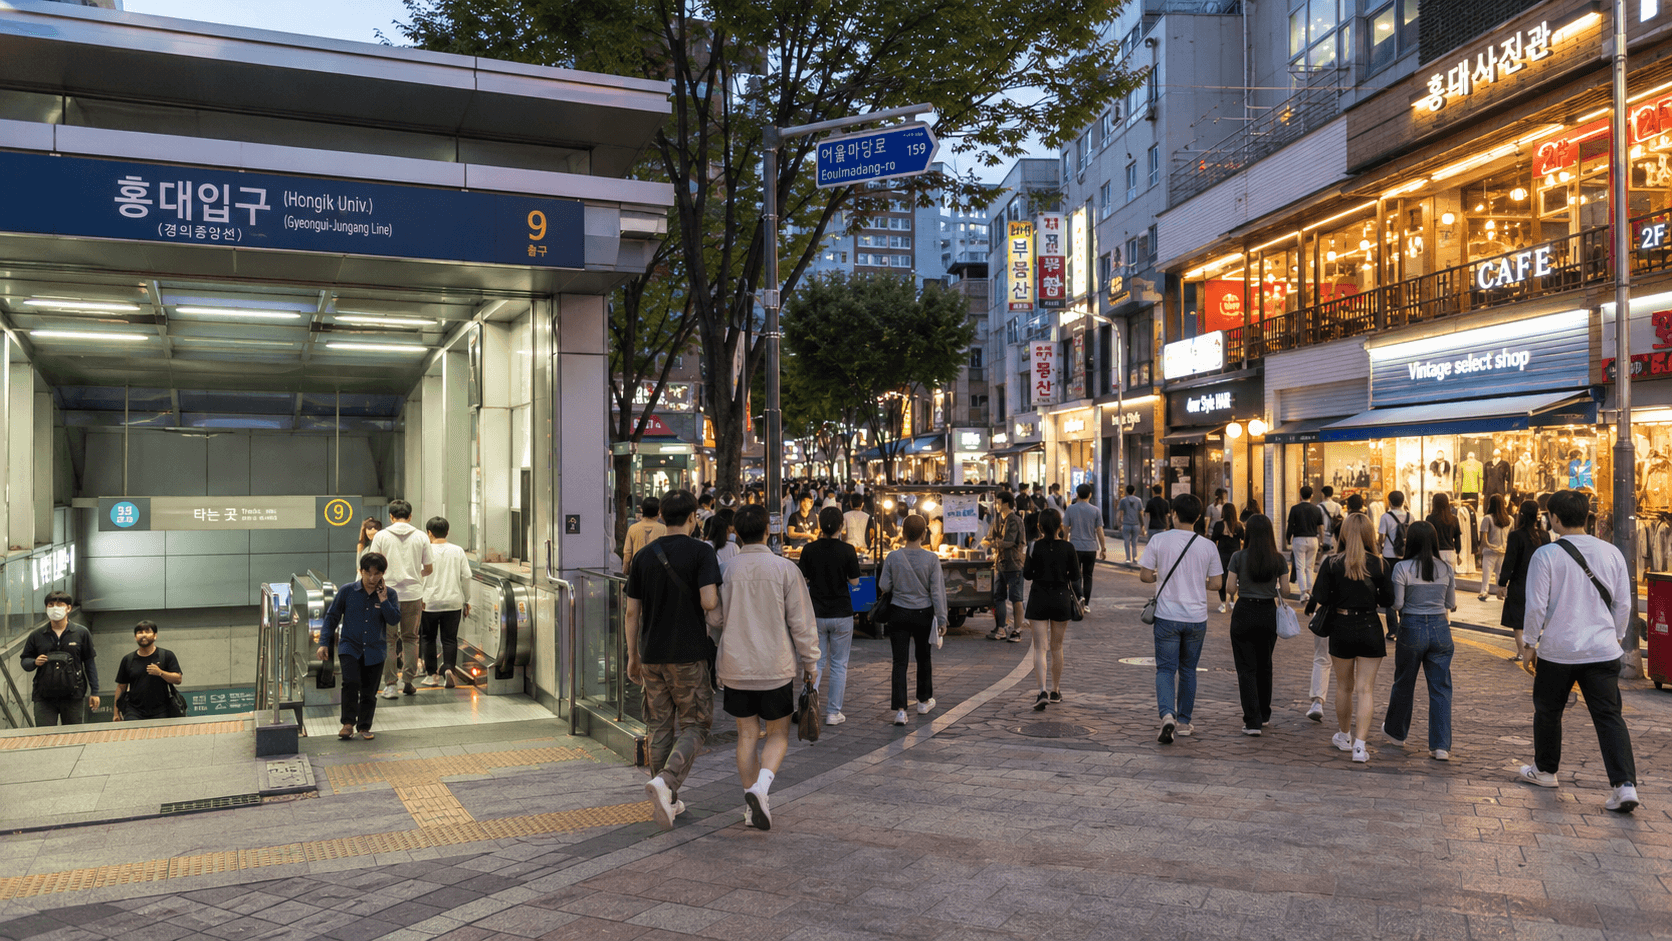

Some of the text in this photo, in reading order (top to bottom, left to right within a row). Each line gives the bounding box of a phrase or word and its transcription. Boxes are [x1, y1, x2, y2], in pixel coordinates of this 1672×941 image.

[1426, 20, 1551, 111] 홍대사진관
[906, 142, 927, 157] 159
[821, 160, 896, 181] Eoulmadang-ro
[114, 175, 271, 226] 홍대입구
[283, 190, 374, 214] (Hongik Univ.)
[283, 214, 393, 237] (Gyeongui-Jungang Line)
[527, 209, 547, 241] 9
[1641, 223, 1666, 249] 2F
[1478, 246, 1553, 290] CAFE
[1408, 348, 1529, 381] Vintage select shop
[193, 508, 221, 522] 타는
[224, 508, 238, 522] 곳
[333, 504, 344, 521] 9
